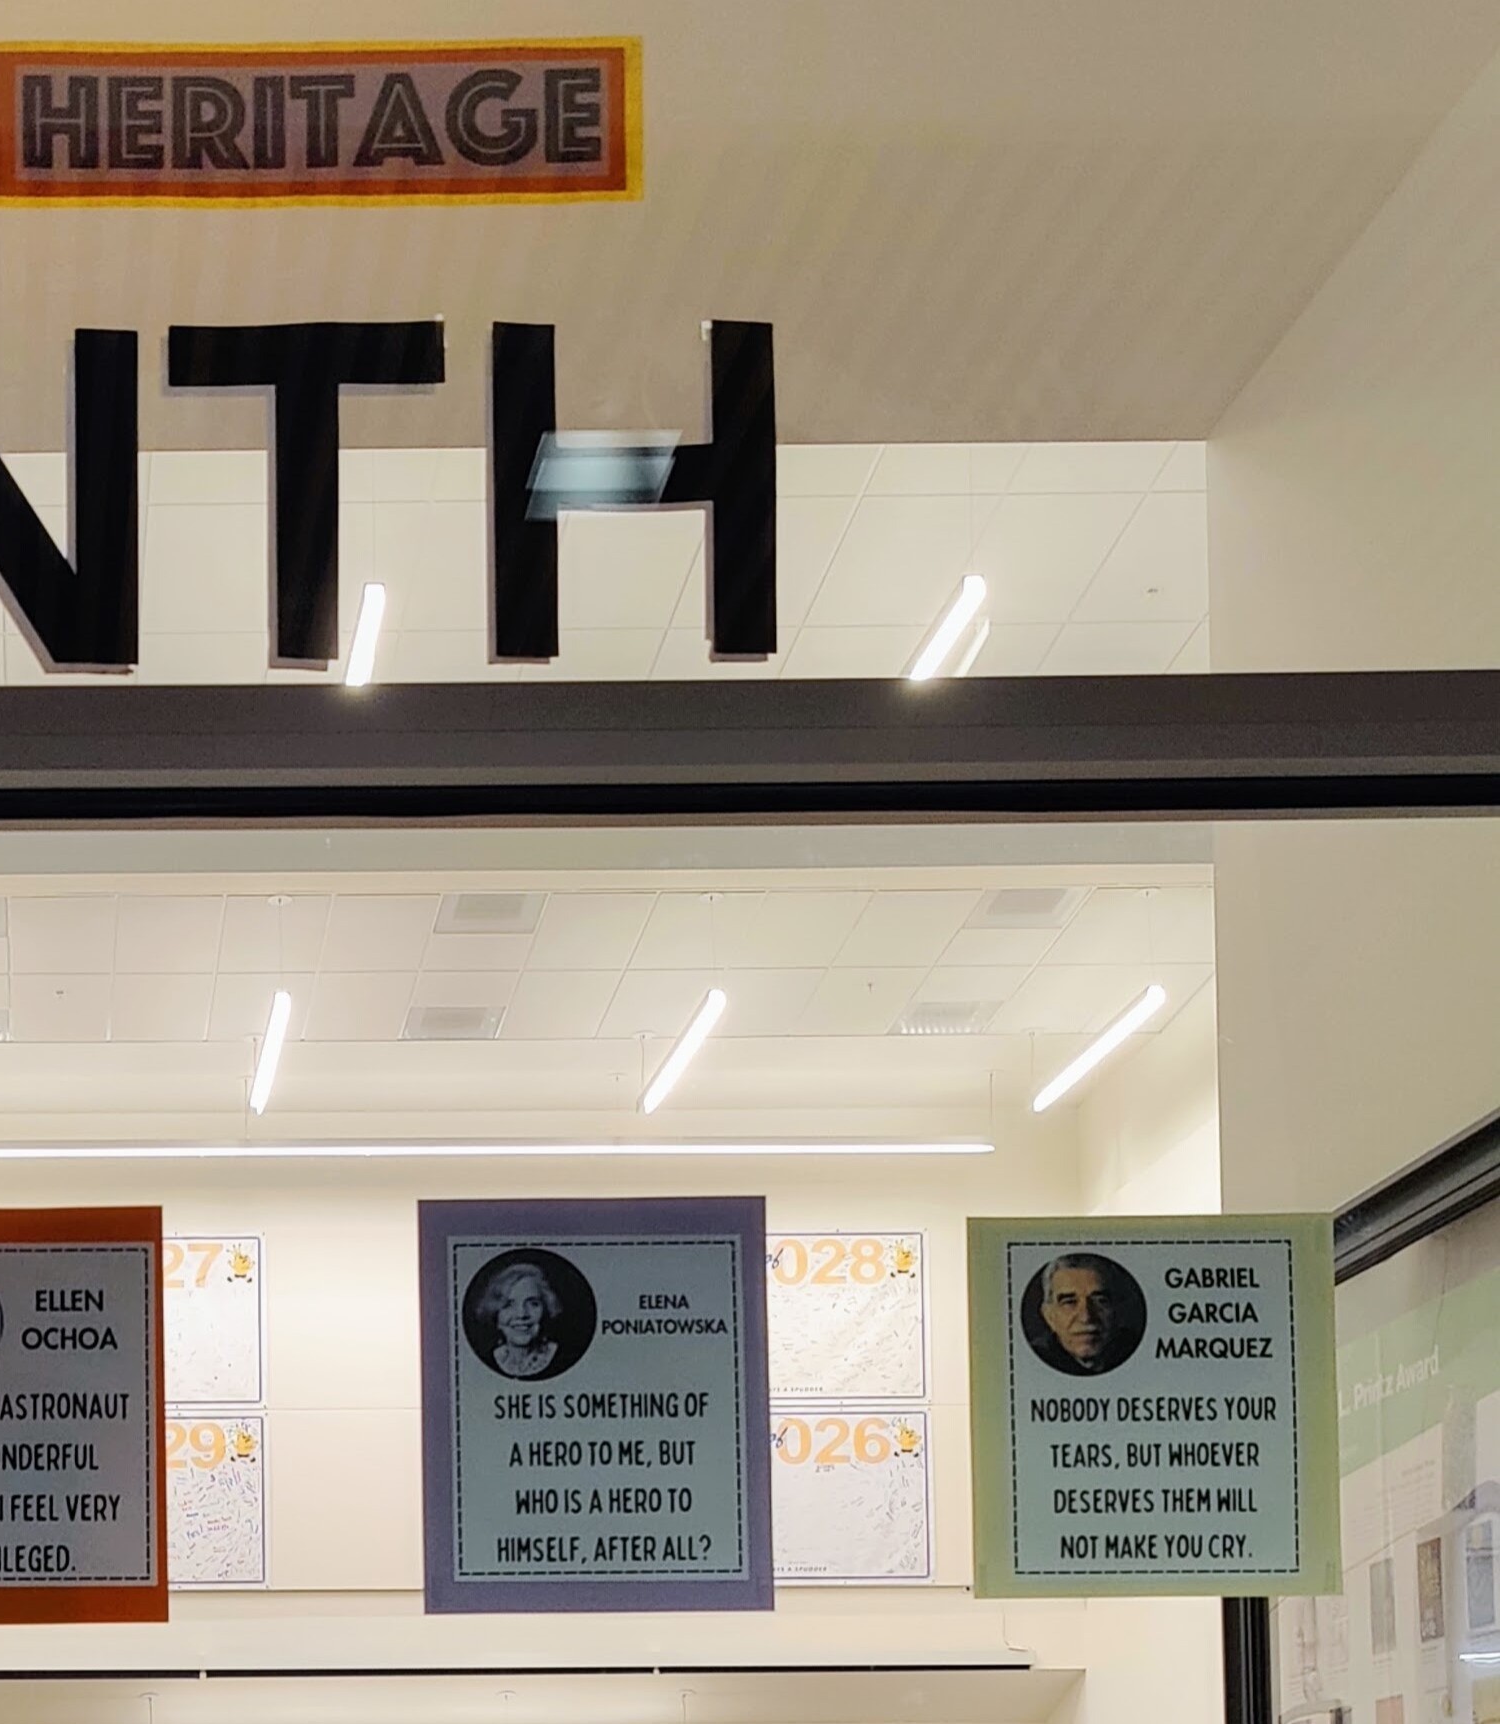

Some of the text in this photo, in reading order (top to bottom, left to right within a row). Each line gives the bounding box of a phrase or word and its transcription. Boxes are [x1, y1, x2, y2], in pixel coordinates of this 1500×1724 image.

[21, 67, 605, 175] HERITAGE
[1165, 1267, 1260, 1289] GABRIEL
[35, 1289, 103, 1312] ELLEN
[639, 1294, 689, 1310] ELENA
[1168, 1302, 1258, 1324] GARCIA
[22, 1327, 118, 1350] OCHOA
[602, 1319, 728, 1335] PONIATOWSKA
[1155, 1337, 1273, 1359] MARQUEZ
[1352, 1372, 1393, 1410] Printz
[1395, 1346, 1439, 1394] Award
[0, 1392, 129, 1421] ASTRONAUT
[494, 1392, 709, 1419] SHE IS SOMETHING OF
[1031, 1396, 1276, 1423] NOBODY DESERVES YOUR
[509, 1440, 695, 1468] A HERO TO ME, BUT
[1050, 1442, 1259, 1469] TEARS, BUT WHOEVER
[0, 1494, 3, 1522] I
[11, 1494, 59, 1522] FEEL
[66, 1494, 120, 1522] VERY
[516, 1488, 692, 1515] WHO IS A HERO TO
[1054, 1488, 1257, 1514] DESERVES THEM WILL
[497, 1534, 711, 1564] HIMSELF, AFTER ALL?
[1061, 1534, 1252, 1559] NOT MAKE YOU CRY.
